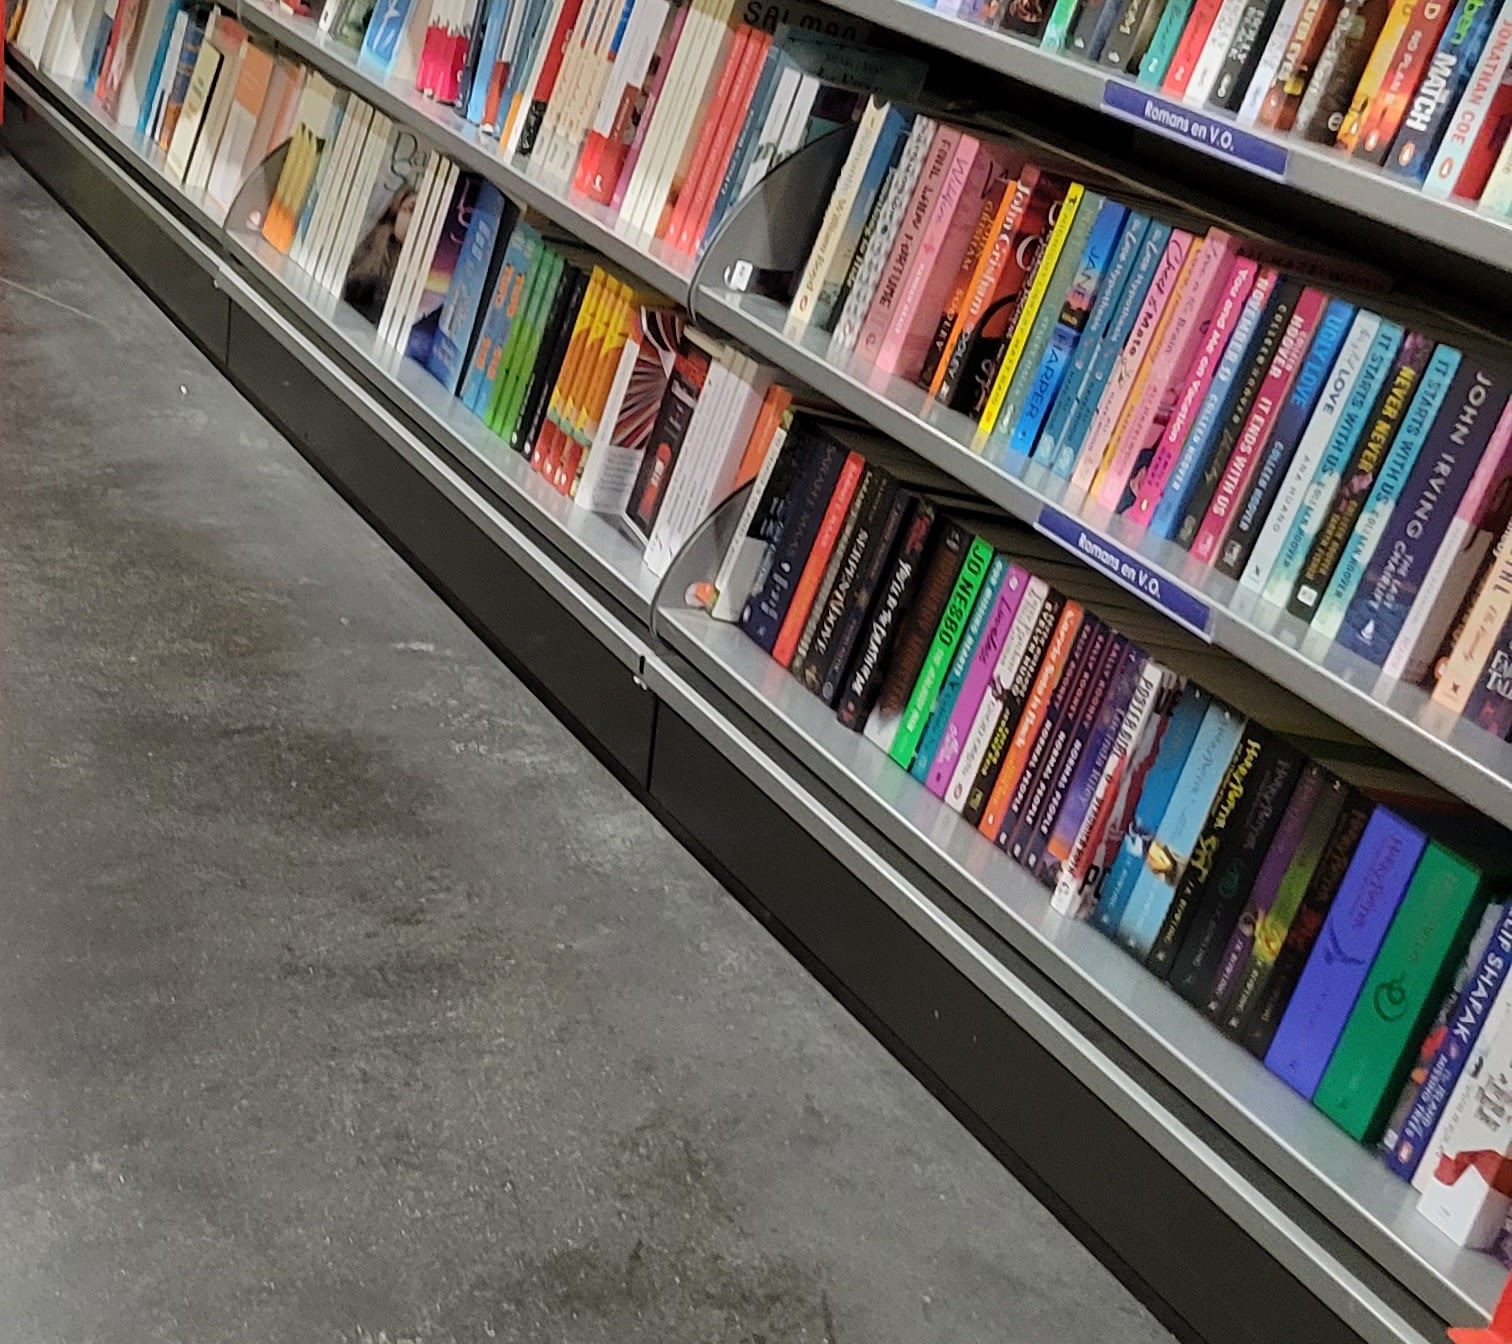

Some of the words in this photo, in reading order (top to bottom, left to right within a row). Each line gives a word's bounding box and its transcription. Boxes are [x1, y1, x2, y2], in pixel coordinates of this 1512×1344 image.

[1404, 48, 1459, 134] MATCH
[1144, 99, 1189, 137] Romans
[1190, 116, 1208, 140] en
[1450, 108, 1477, 147] COE
[1000, 180, 1033, 233] John
[967, 232, 1012, 319] Grisham
[1067, 242, 1108, 305] JANE
[1225, 265, 1251, 301] You
[1126, 308, 1156, 359] Mate
[1162, 315, 1189, 357] Brain
[1214, 297, 1238, 332] and
[1223, 275, 1272, 365] NOVEMBER
[1310, 311, 1347, 367] UGLY
[1195, 355, 1212, 379] on
[1266, 312, 1306, 381] HOOVER
[1376, 332, 1394, 352] IT
[1433, 357, 1451, 377] IT
[1021, 331, 1074, 424] HARPER
[1290, 360, 1323, 411] LOVE
[1321, 366, 1353, 418] LOVE
[1349, 350, 1387, 413] STARTS
[1380, 363, 1419, 421] NEVER
[1164, 378, 1204, 446] Vacation
[1256, 395, 1275, 416] IT
[1405, 378, 1444, 439] STARTS
[1446, 369, 1496, 447] JOHN
[1238, 412, 1268, 456] ENDS
[1330, 409, 1361, 455] WITH
[1356, 418, 1395, 475] NEVER
[1220, 453, 1249, 496] WITH
[1319, 452, 1341, 478] US
[1386, 438, 1417, 483] WITH
[1209, 492, 1232, 519] US
[1375, 480, 1397, 507] US
[1402, 450, 1458, 542] IRVING
[964, 543, 989, 578] JO
[1077, 532, 1120, 576] Romans
[1120, 562, 1136, 585] en
[1026, 719, 1056, 772] NORMAL
[1040, 729, 1069, 782] NORMAL
[1055, 738, 1085, 790] NORMAL
[1007, 768, 1036, 817] PEOPLE
[1022, 779, 1050, 828] PEOPLE
[1037, 787, 1065, 836] PEOPLE
[1450, 950, 1507, 1044] SHAFAK
